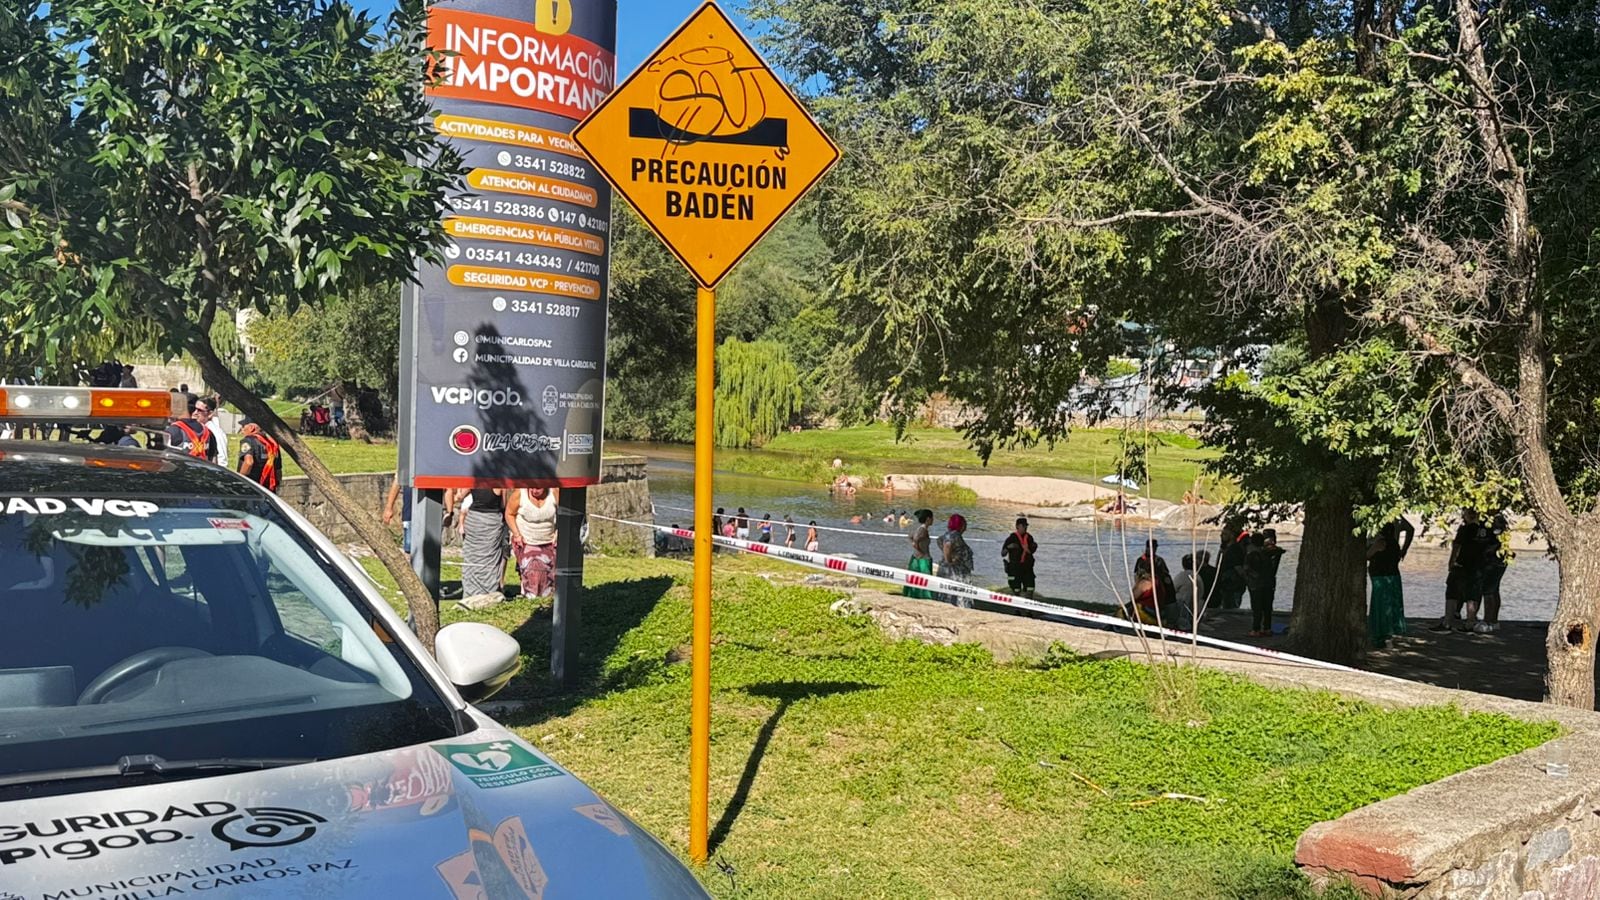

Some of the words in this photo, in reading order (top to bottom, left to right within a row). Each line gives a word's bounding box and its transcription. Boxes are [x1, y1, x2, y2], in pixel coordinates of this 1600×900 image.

[446, 24, 612, 89] INFORMACIÓN
[443, 56, 607, 111] IMPORTANT
[440, 122, 515, 139] ACTIVIDADES
[518, 132, 544, 144] PARA
[515, 156, 546, 171] 3541
[549, 161, 586, 179] 528822
[631, 157, 787, 190] PRECAUCIÓN
[480, 176, 536, 191] ATENCIÓN
[538, 182, 549, 193] AL
[551, 185, 593, 203] CIUDADANO
[452, 198, 489, 212] 3541
[493, 201, 544, 219] 528386
[560, 210, 576, 224] 147
[666, 187, 754, 221] BADÉN
[455, 222, 534, 239] EMERGENCIAS
[536, 228, 552, 242] VÍA
[554, 231, 582, 247] PÚBLICA
[466, 247, 510, 263] 03541
[515, 253, 562, 269] 434343
[574, 260, 600, 276] 421700
[464, 271, 527, 287] SEGURIDAD
[529, 277, 549, 289] VCP
[511, 300, 542, 314] 3541
[545, 303, 580, 318] 528817
[475, 334, 552, 348] @MUNICARLOSPAZ
[475, 353, 541, 366] MUNICIPALIDAD
[542, 358, 552, 366] DE
[553, 358, 570, 368] VILLA
[0, 498, 67, 514] AD
[71, 498, 159, 517] VCP
[43, 858, 276, 900] MUNICIPALIDAD
[192, 867, 301, 890] CARLOS
[307, 859, 359, 873] PAZ
